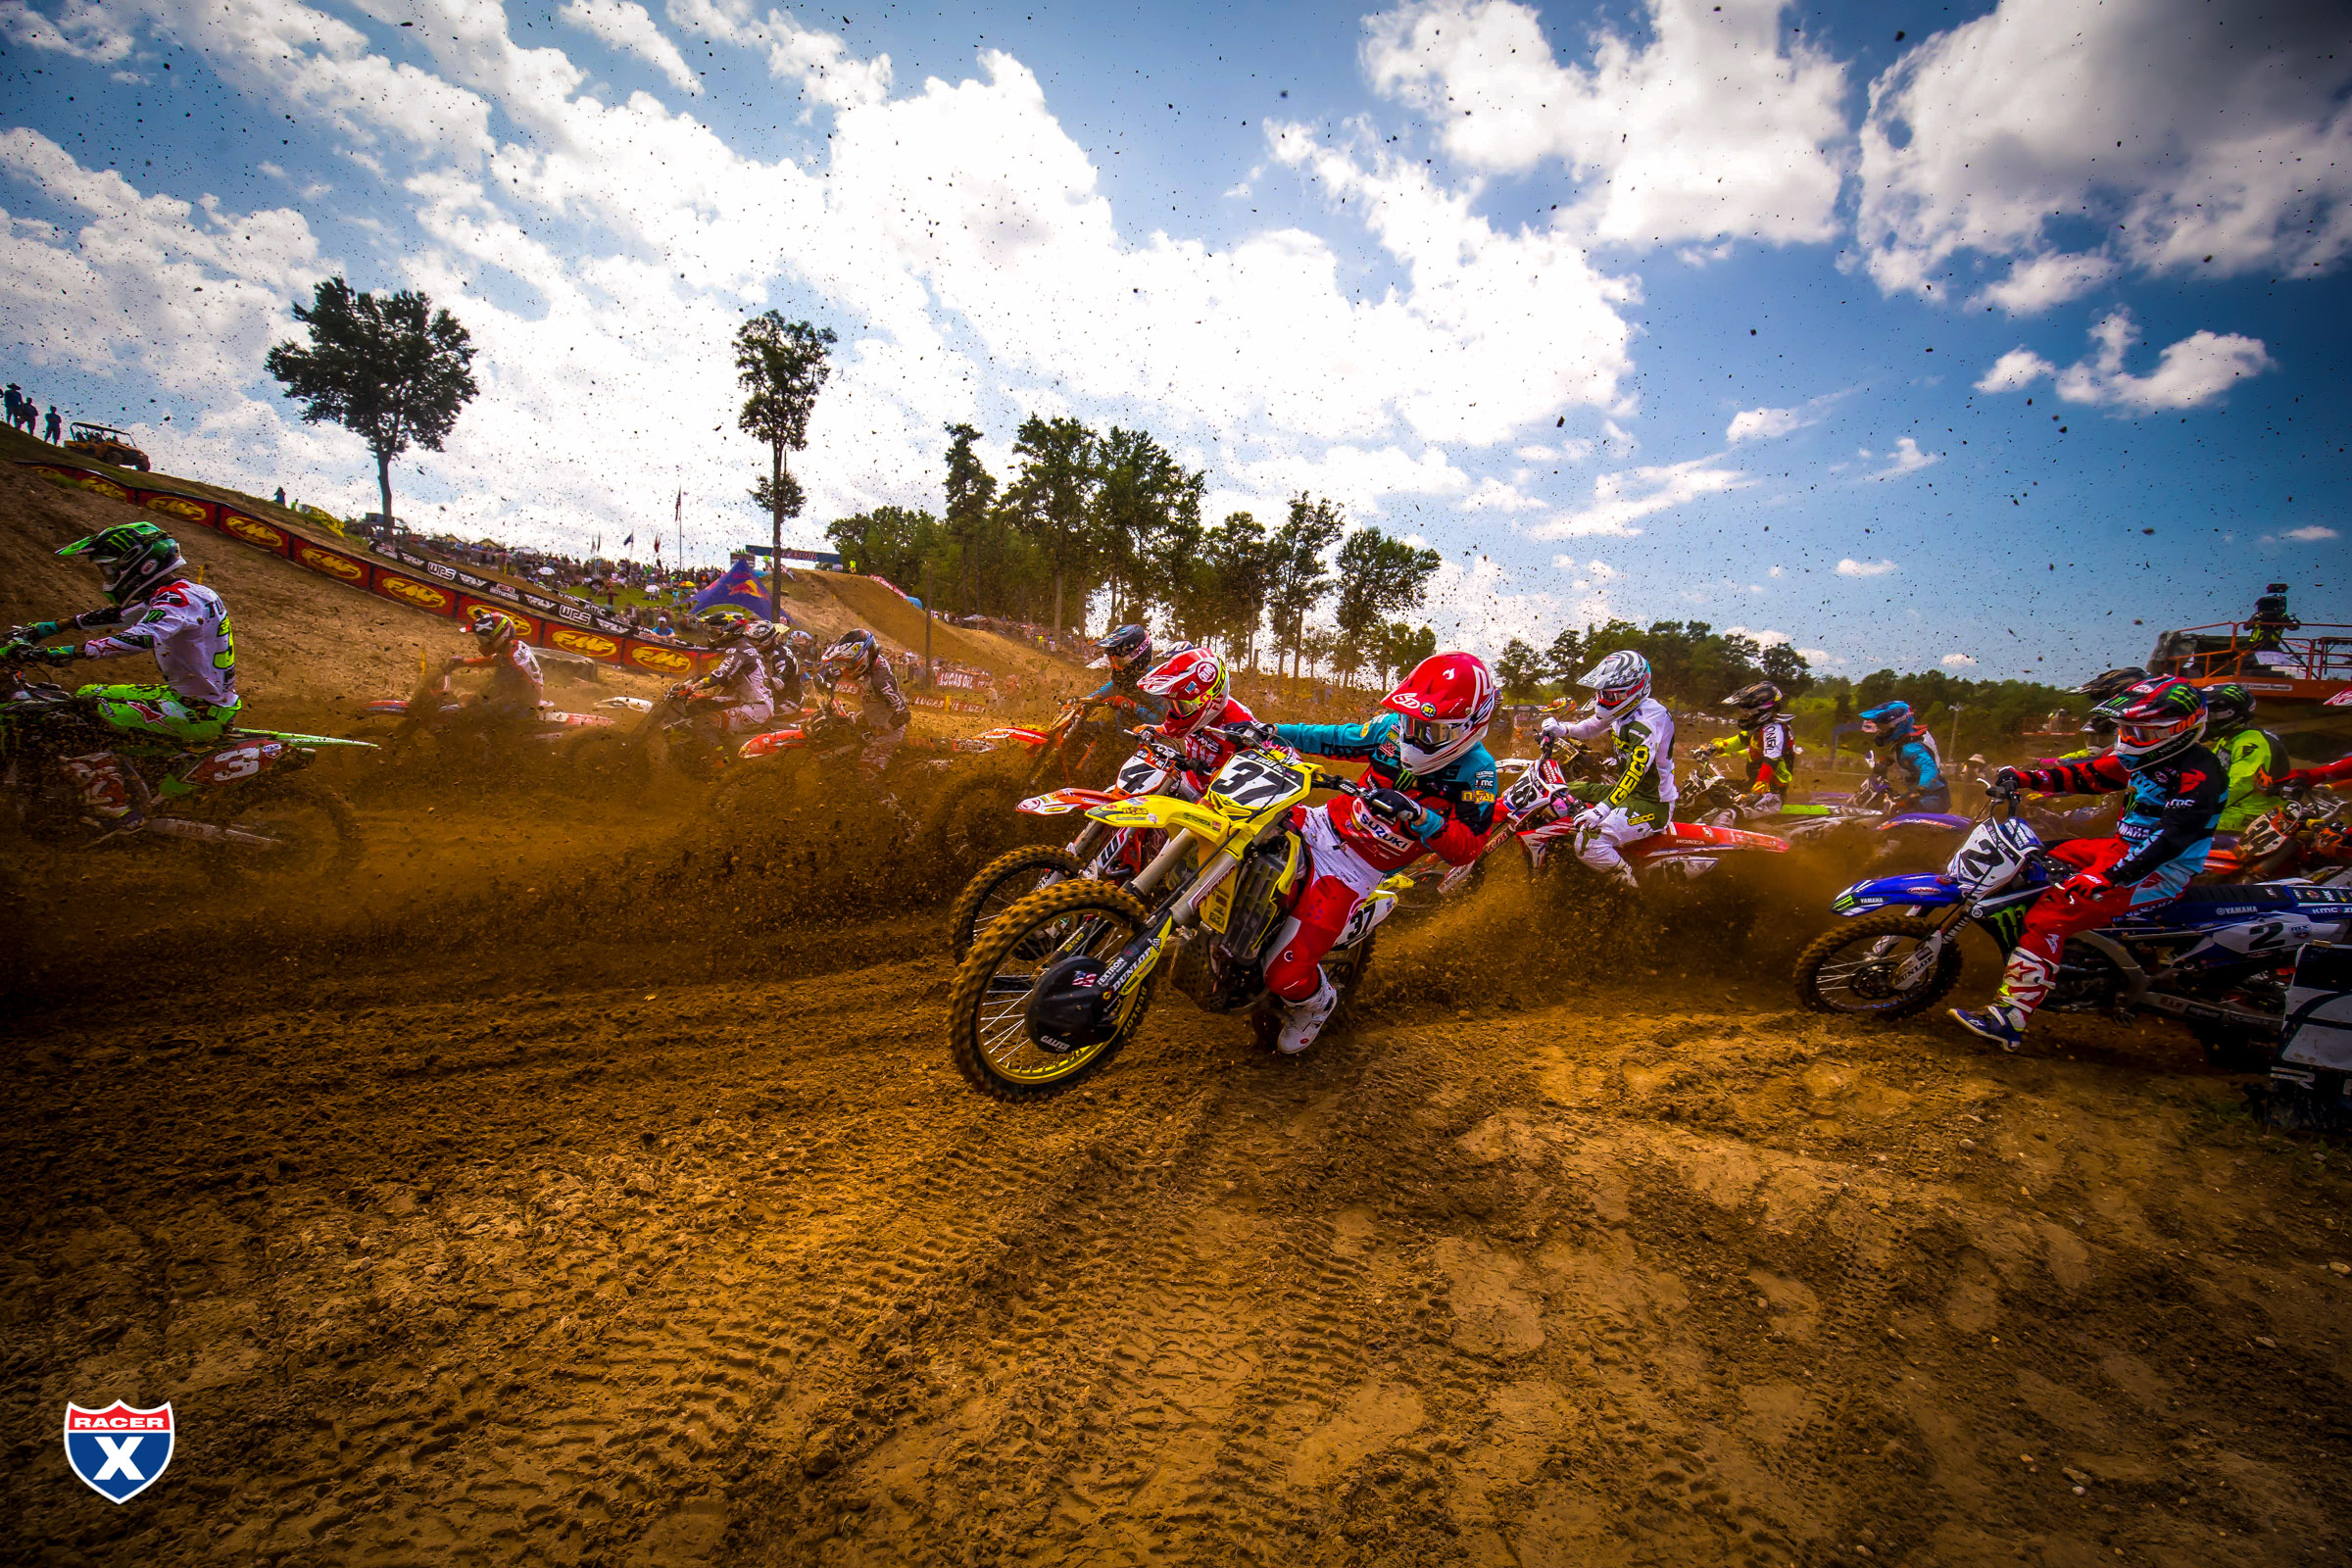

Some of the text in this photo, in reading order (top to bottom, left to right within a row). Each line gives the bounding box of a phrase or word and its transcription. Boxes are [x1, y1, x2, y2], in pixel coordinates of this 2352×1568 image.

[227, 517, 281, 545] FMF
[303, 549, 360, 576] FMF
[384, 578, 445, 607] FMF
[428, 562, 456, 580] WPS
[524, 594, 557, 609] FLY
[560, 605, 591, 625] WPS
[584, 604, 606, 616] KMC
[554, 631, 616, 656] FMF
[633, 648, 690, 671] FMF
[939, 672, 973, 689] LUCAS OIL
[915, 696, 944, 708] LUCAS
[2169, 708, 2205, 735] 100%
[214, 747, 260, 782] 3
[1609, 745, 1649, 806] GEICO
[1210, 761, 1298, 807] 37
[1191, 815, 1211, 827] TOYOTA
[1360, 813, 1408, 849] SUZUKI
[1628, 813, 1655, 826] GEICO
[1961, 839, 2005, 878] 2
[1348, 902, 1376, 940] 37
[2225, 906, 2258, 914] YAMAHA
[2249, 922, 2285, 951] 2
[1098, 957, 1126, 985] TEXTRON
[1112, 947, 1152, 992] DUNLOP
[1895, 955, 1935, 984] DUNLOP
[1122, 986, 1148, 1036] DUNLOP
[1040, 1035, 1071, 1051] GALFER
